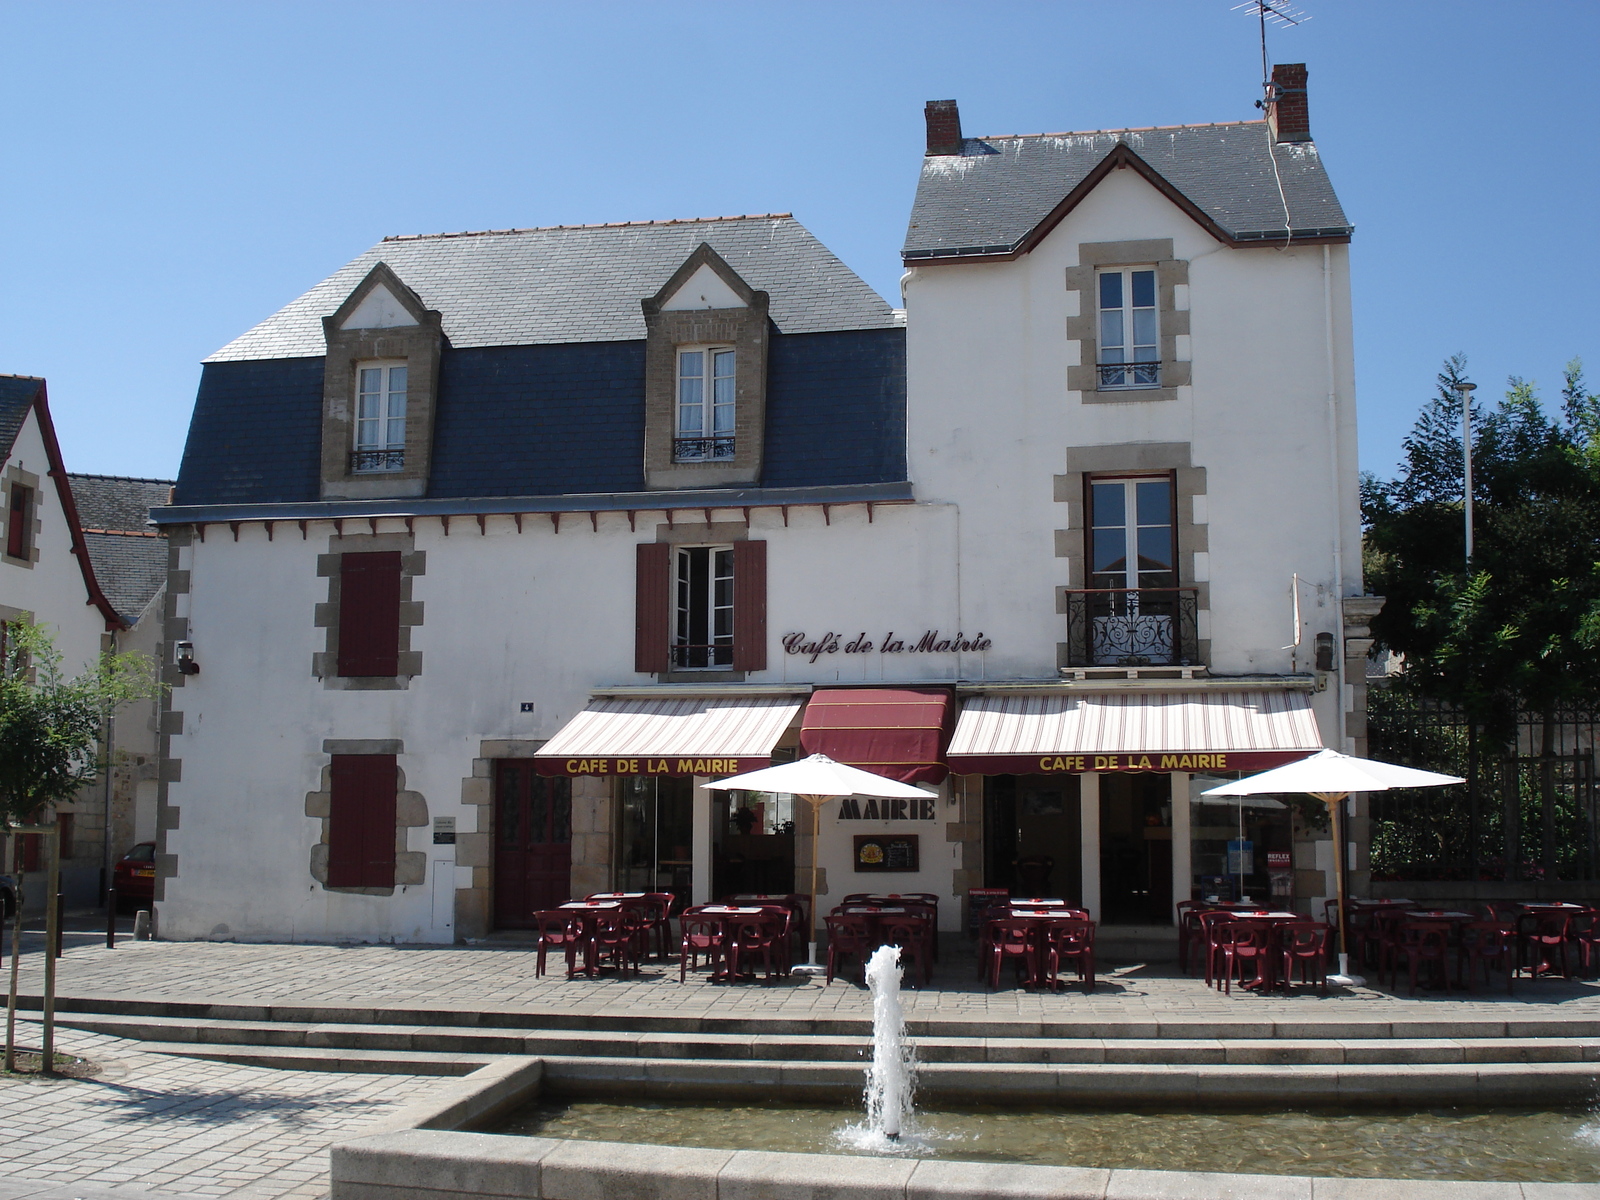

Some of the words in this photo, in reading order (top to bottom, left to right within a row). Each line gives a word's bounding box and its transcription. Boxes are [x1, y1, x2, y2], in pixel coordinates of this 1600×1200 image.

[782, 632, 842, 663] Café
[844, 632, 874, 654] de
[880, 632, 904, 653] la
[908, 629, 992, 653] Mairie
[566, 759, 608, 773] CAFE
[616, 759, 639, 773] DE
[647, 759, 669, 773] LA
[676, 759, 738, 773] MAIRIE
[1039, 756, 1085, 771] CAFE
[1094, 755, 1119, 769] DE
[1128, 755, 1152, 769] LA
[1160, 754, 1227, 769] MAIRIE
[838, 799, 935, 820] MAIRIE
